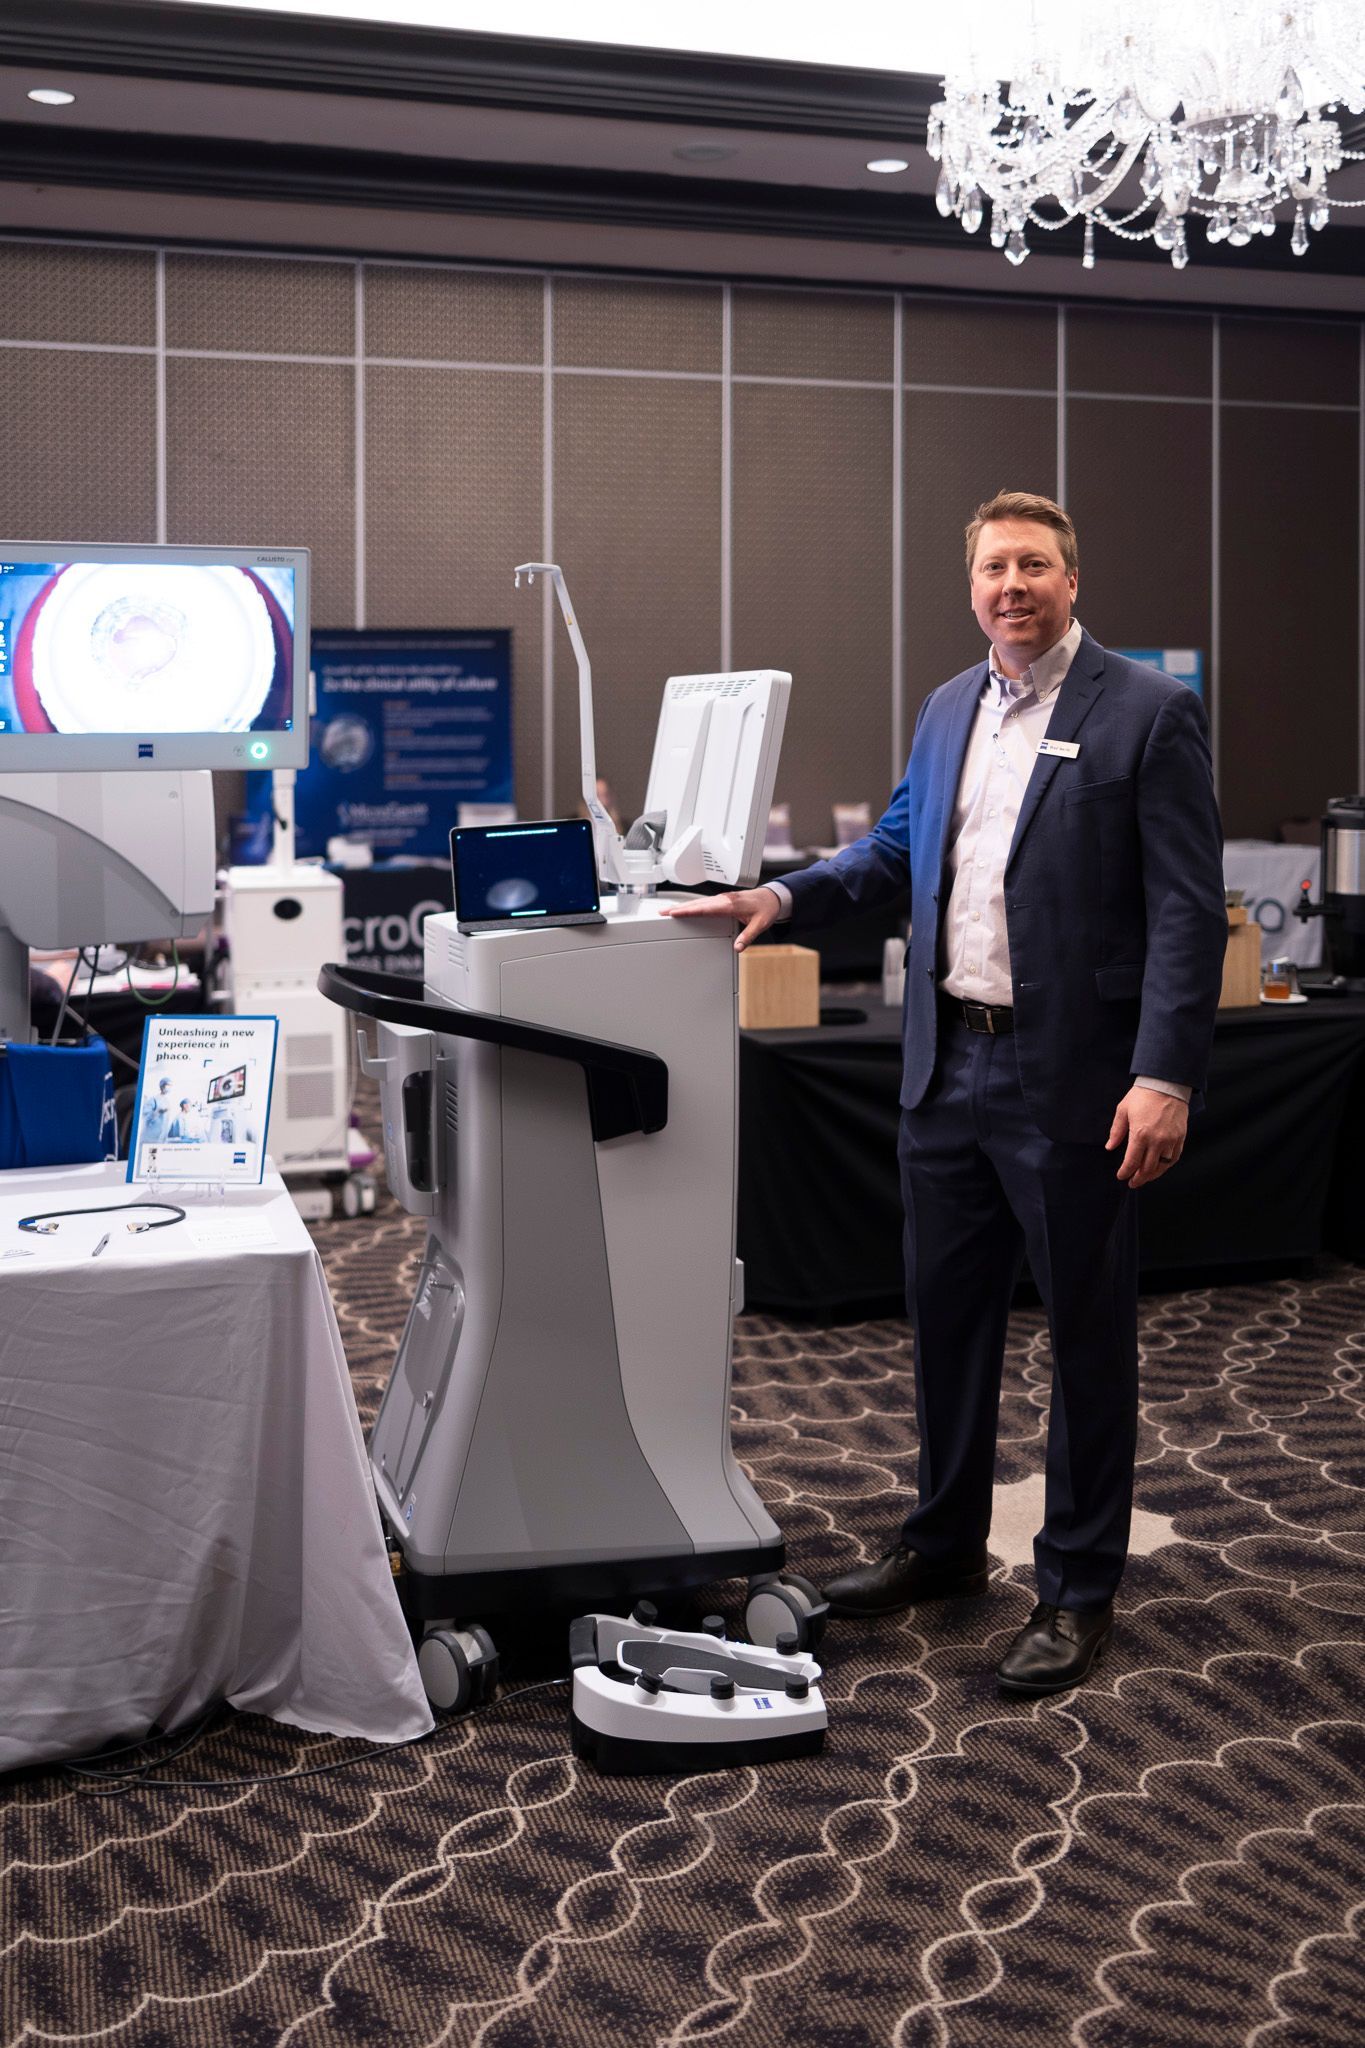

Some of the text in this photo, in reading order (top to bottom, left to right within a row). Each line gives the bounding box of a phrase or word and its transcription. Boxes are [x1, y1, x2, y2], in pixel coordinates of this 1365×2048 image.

[159, 1028, 218, 1039] Unleashing
[157, 1041, 216, 1050] experience
[156, 1052, 191, 1062] phaco.
